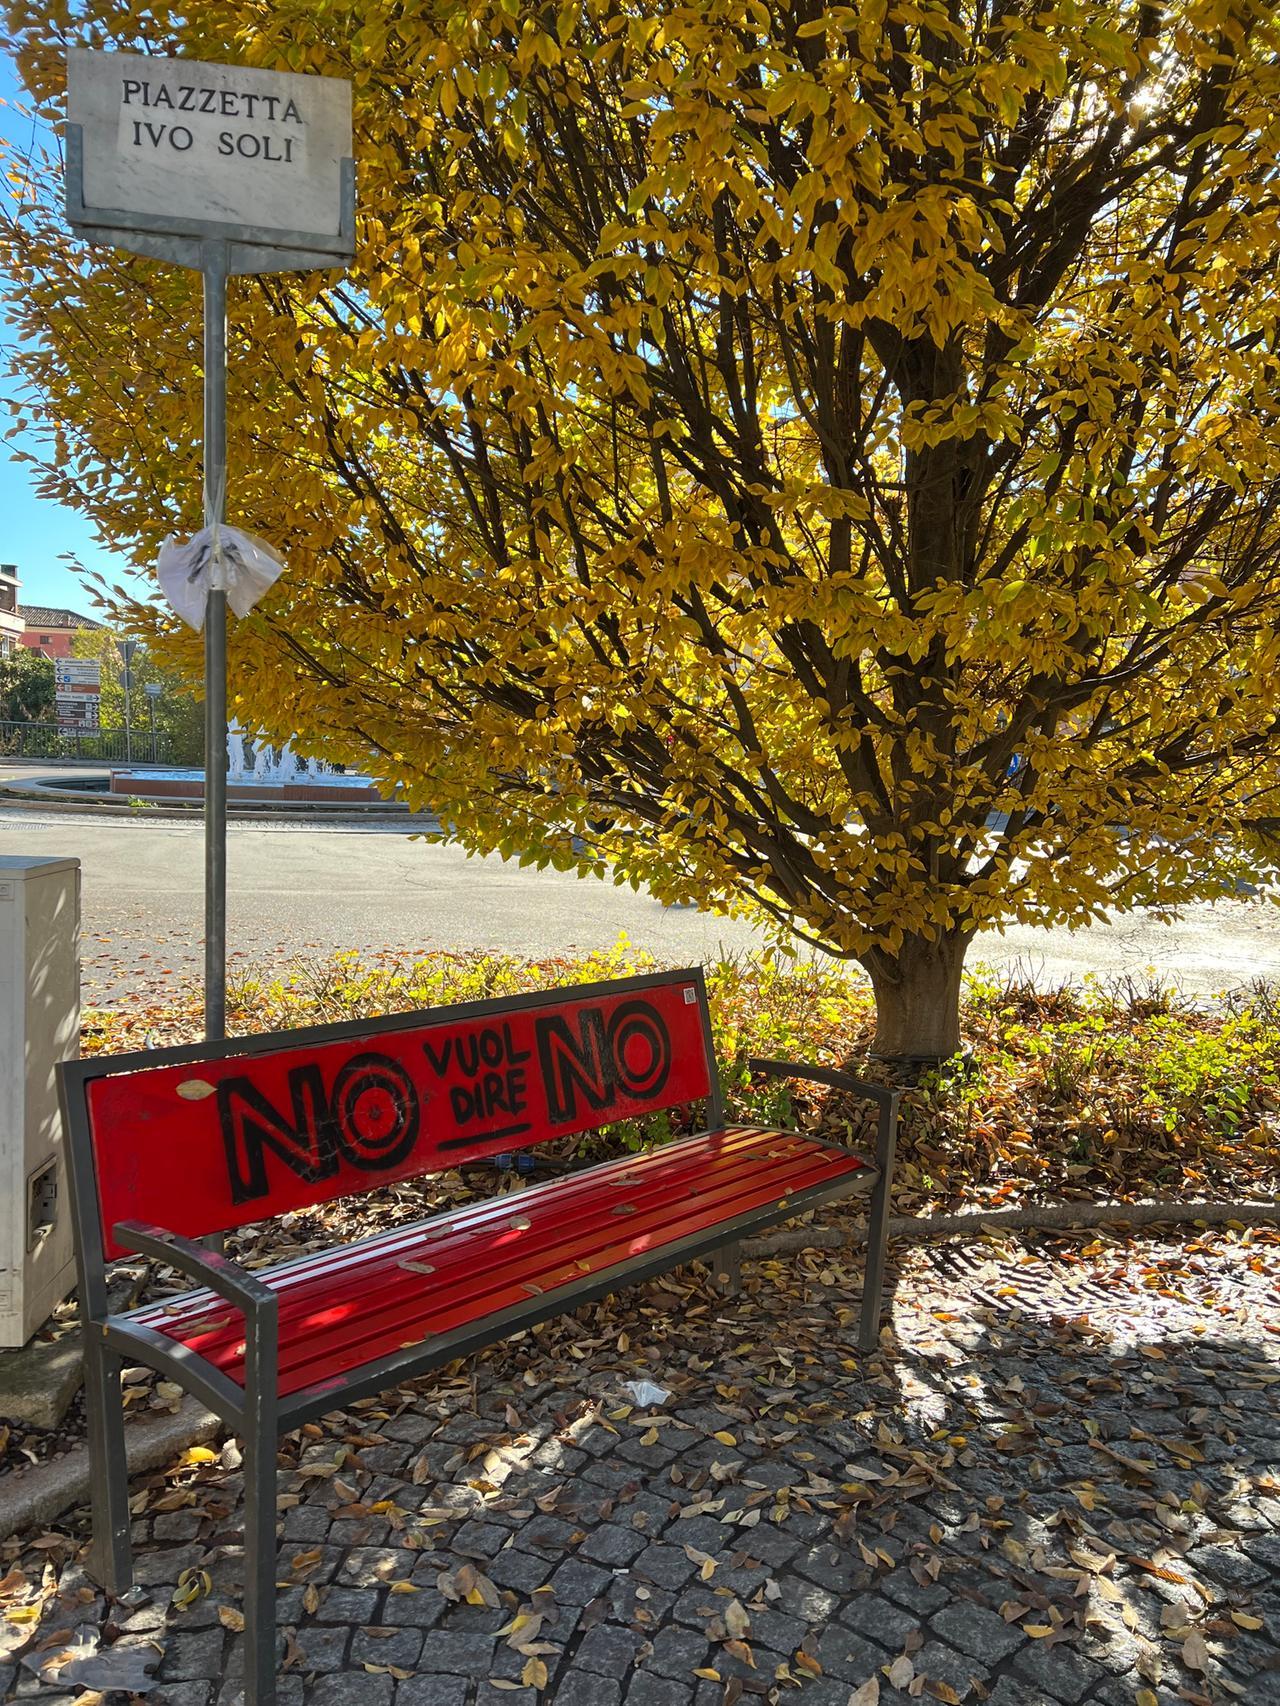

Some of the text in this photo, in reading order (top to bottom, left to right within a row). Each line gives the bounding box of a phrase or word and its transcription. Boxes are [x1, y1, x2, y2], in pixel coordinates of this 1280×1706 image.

[122, 79, 303, 124] PIAZZETTA
[132, 121, 293, 162] IVO SOLI
[422, 1022, 532, 1078] VUOL
[534, 1000, 672, 1124] NO
[450, 1068, 528, 1125] DIRE
[216, 1052, 420, 1206] NO
